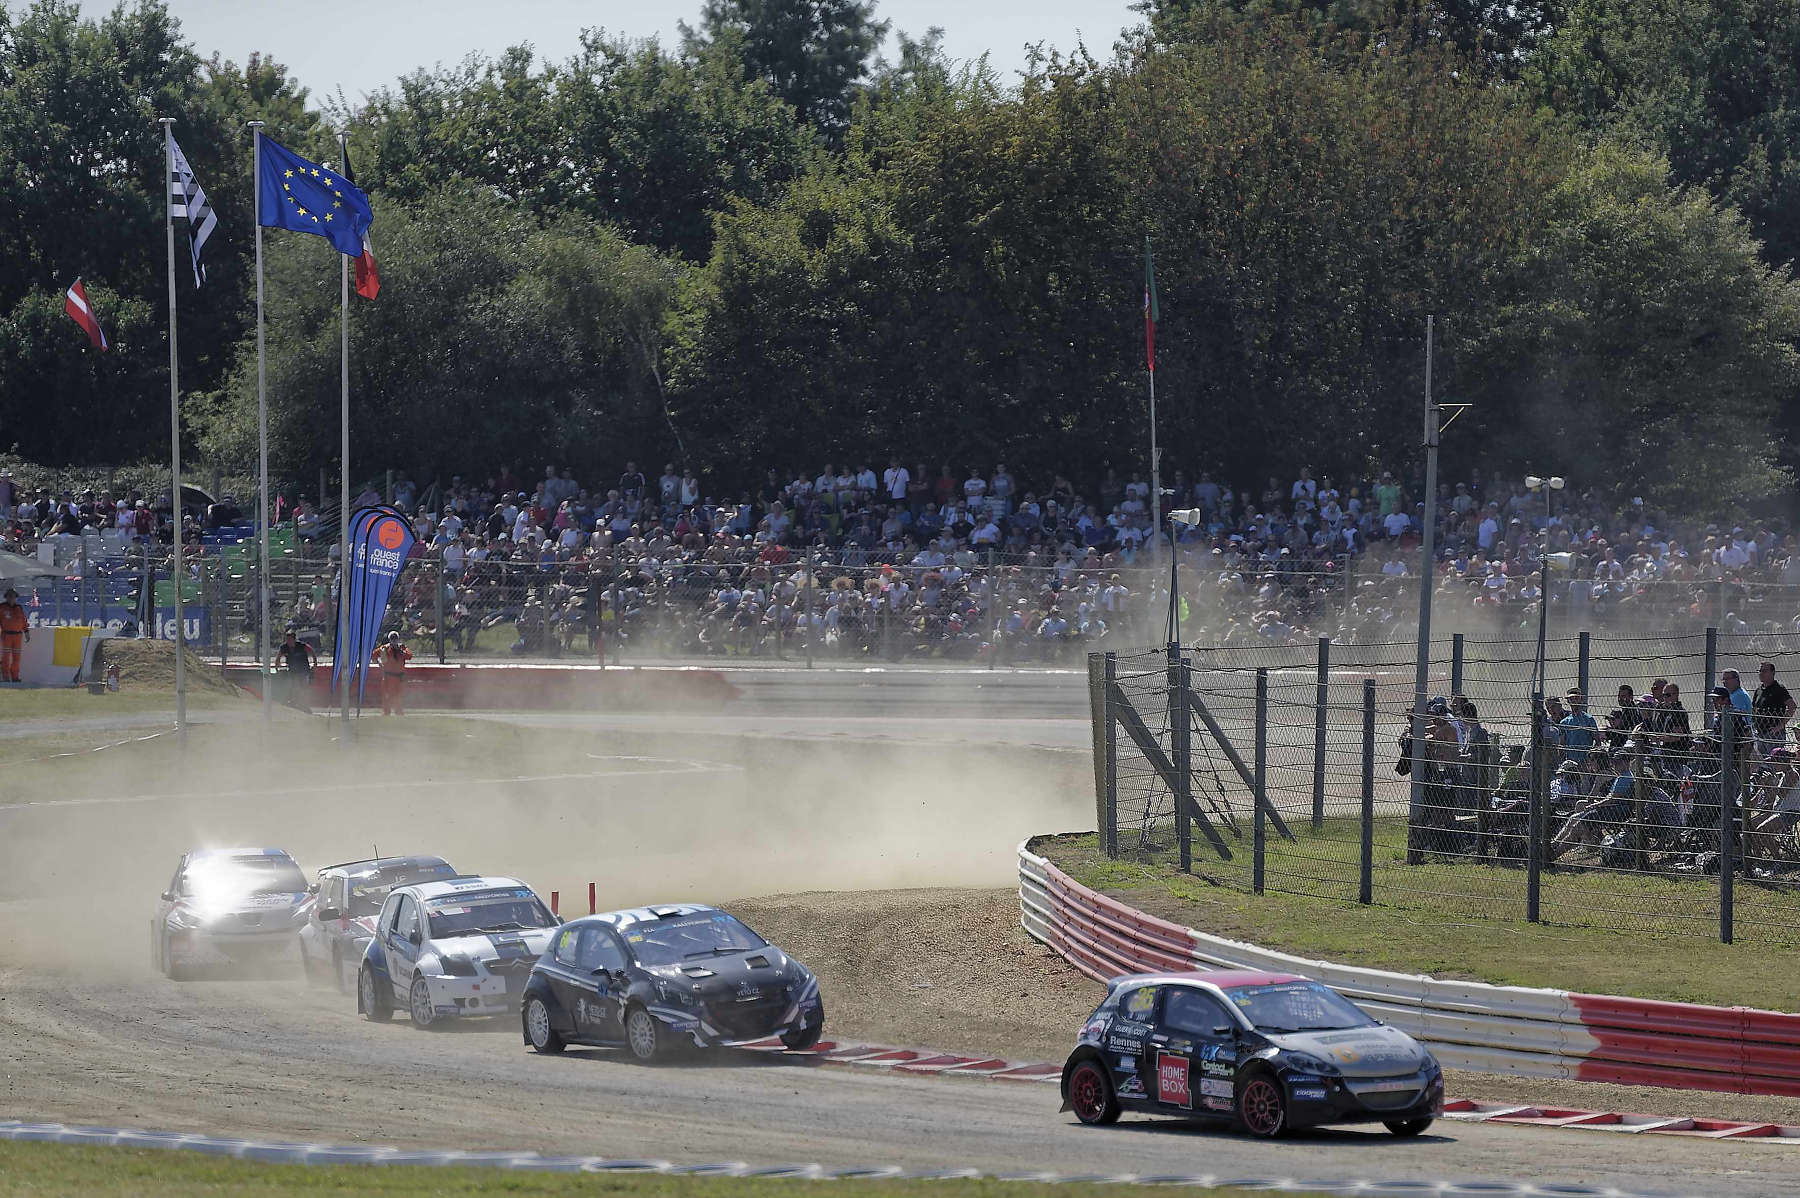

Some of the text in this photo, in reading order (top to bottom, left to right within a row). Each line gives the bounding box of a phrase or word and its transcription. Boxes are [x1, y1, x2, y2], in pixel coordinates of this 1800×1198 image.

[370, 553, 399, 570] france
[1110, 1035, 1142, 1048] Rennes
[1162, 1066, 1185, 1080] HOME
[1162, 1079, 1186, 1095] BOX
